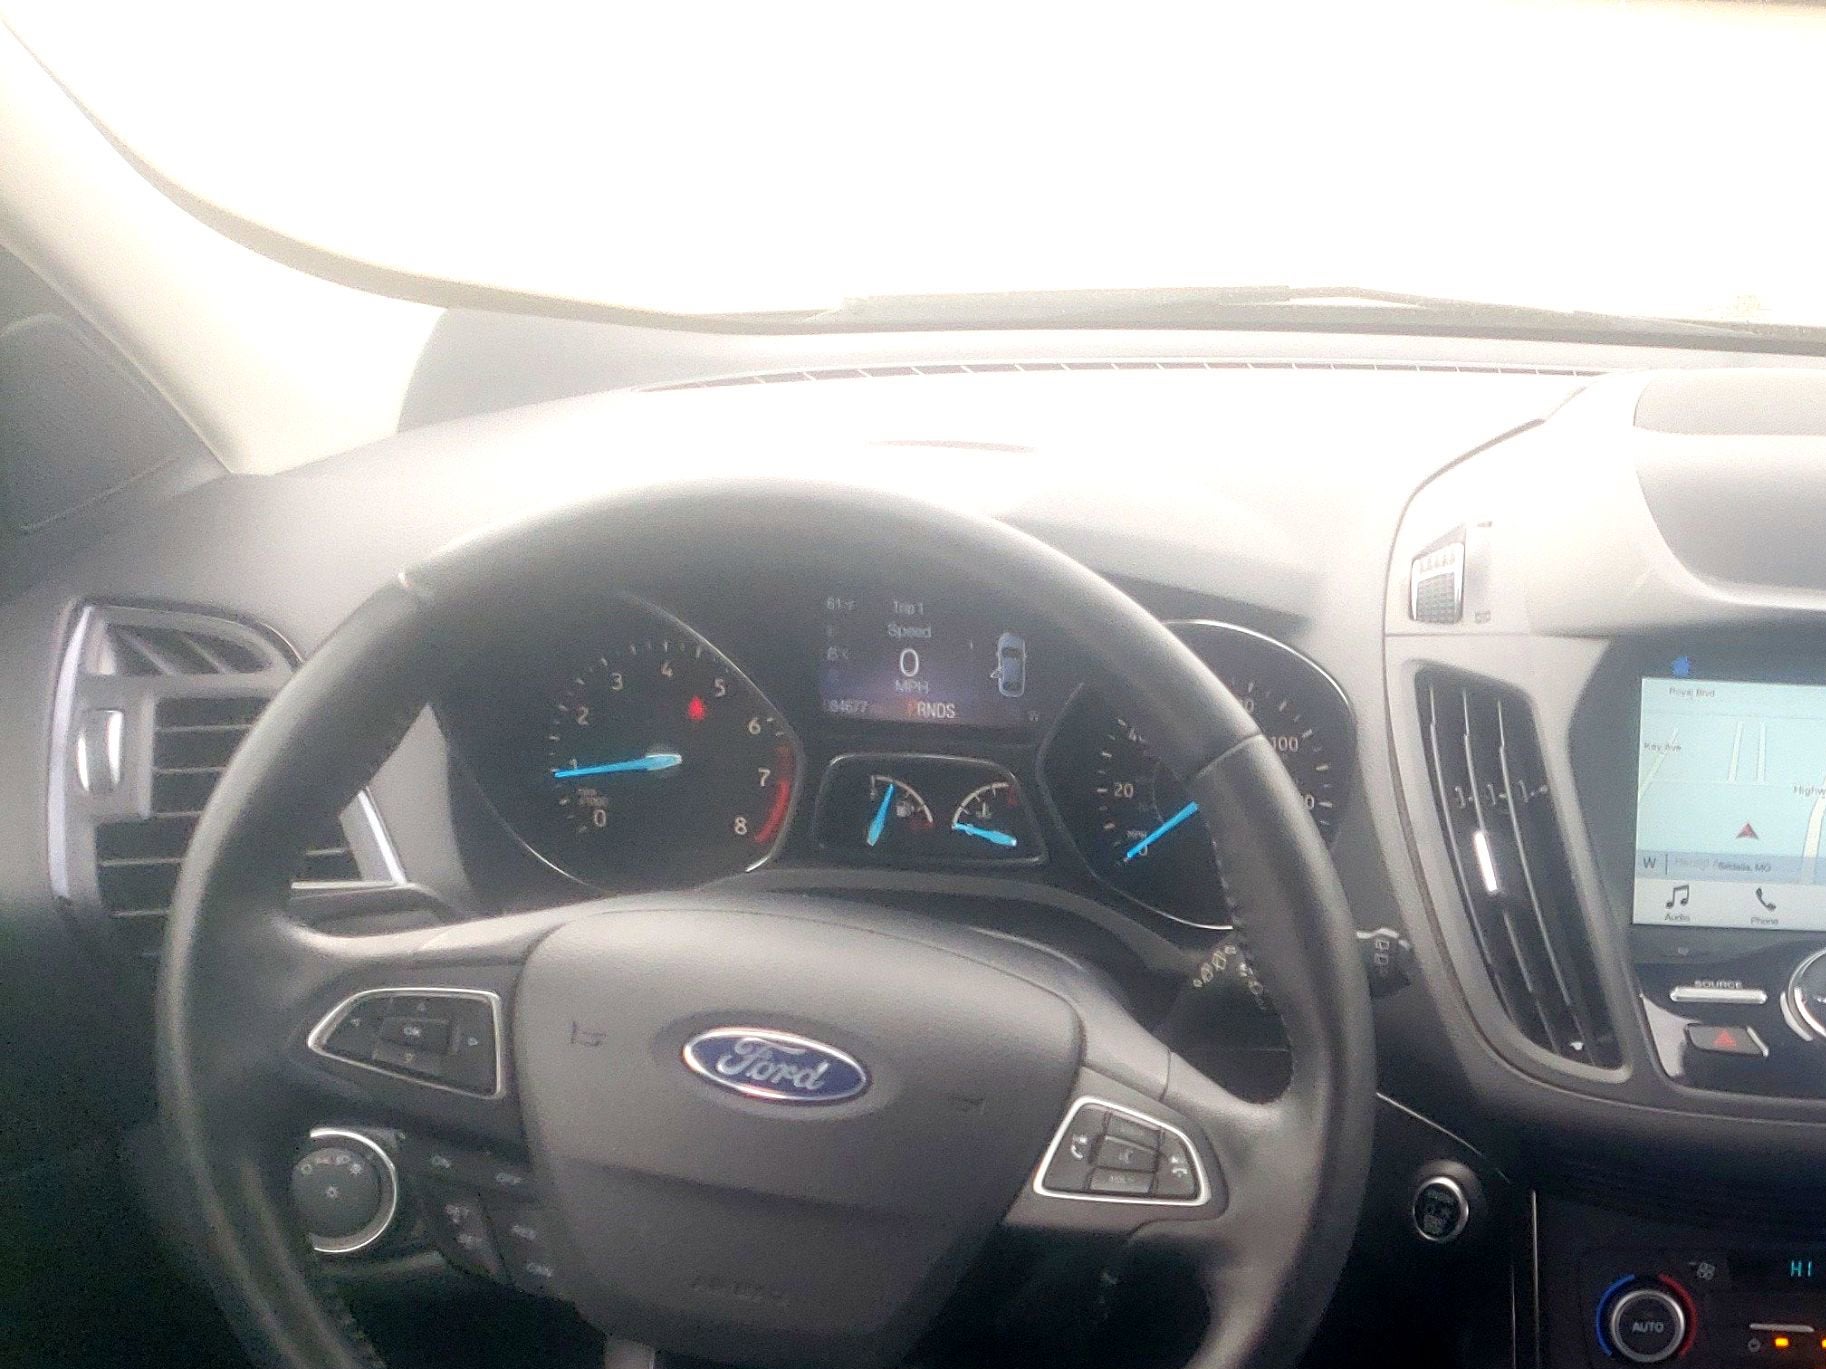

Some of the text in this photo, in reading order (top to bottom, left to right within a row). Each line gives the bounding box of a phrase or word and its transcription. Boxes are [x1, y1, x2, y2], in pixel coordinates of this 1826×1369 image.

[888, 622, 932, 638] Speed
[661, 661, 674, 678] 4
[900, 648, 919, 678] 0
[611, 672, 624, 691] 3
[714, 678, 726, 698] 5
[896, 680, 929, 694] MPH
[576, 706, 589, 726] 2
[748, 716, 761, 735] 6
[758, 767, 771, 787] 7
[1114, 783, 1134, 798] 20
[593, 809, 607, 827] 0
[734, 816, 748, 835] 8
[1643, 857, 1656, 869] W
[1664, 912, 1690, 922] Audio
[1751, 916, 1779, 925] Phone
[1694, 980, 1743, 988] SOURCE
[716, 1037, 830, 1091] Ford
[1790, 1260, 1812, 1277] HI
[1632, 1321, 1665, 1333] AUTO
